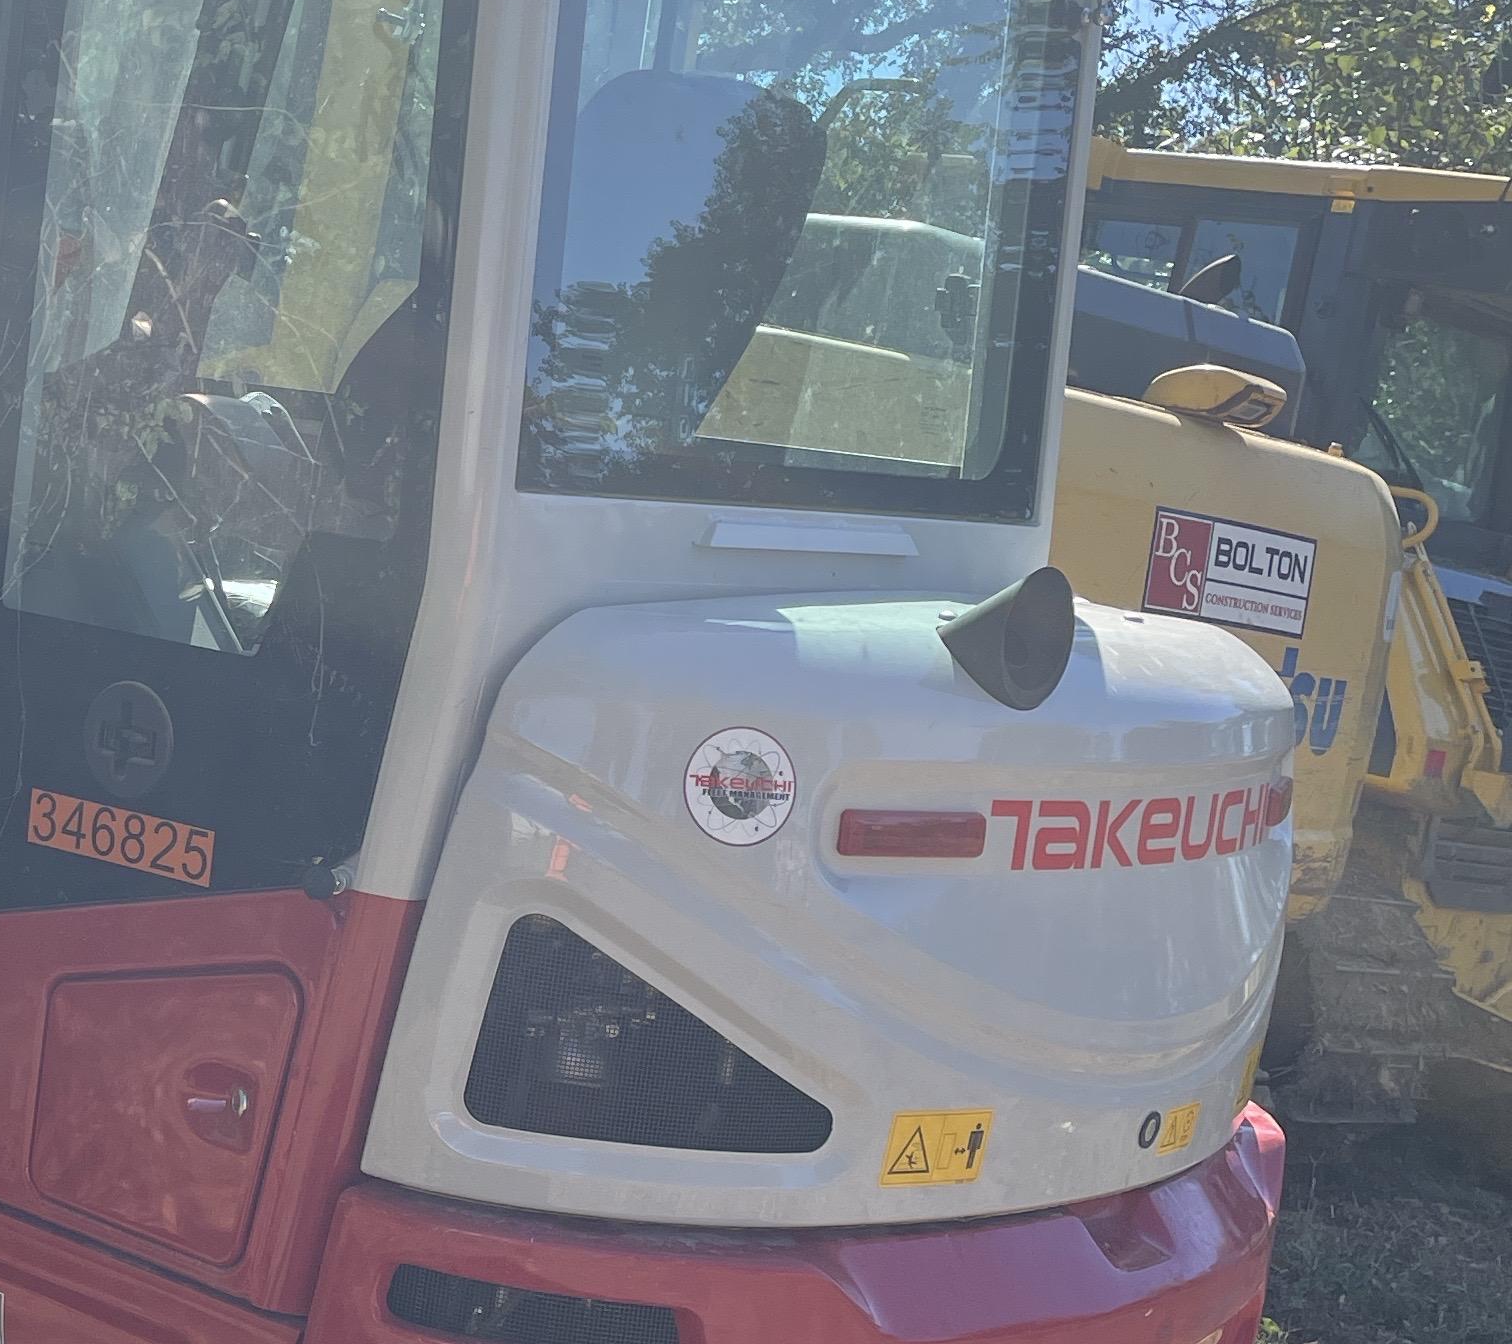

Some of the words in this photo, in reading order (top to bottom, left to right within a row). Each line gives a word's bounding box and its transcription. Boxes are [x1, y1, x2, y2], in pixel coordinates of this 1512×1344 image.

[1214, 536, 1308, 585] BOLTON
[1205, 592, 1269, 615] CONSTRUCTION
[1270, 603, 1302, 621] SERVICES
[702, 788, 727, 798] FLEET
[729, 789, 791, 801] MANAGEMENT
[33, 792, 209, 881] 346825
